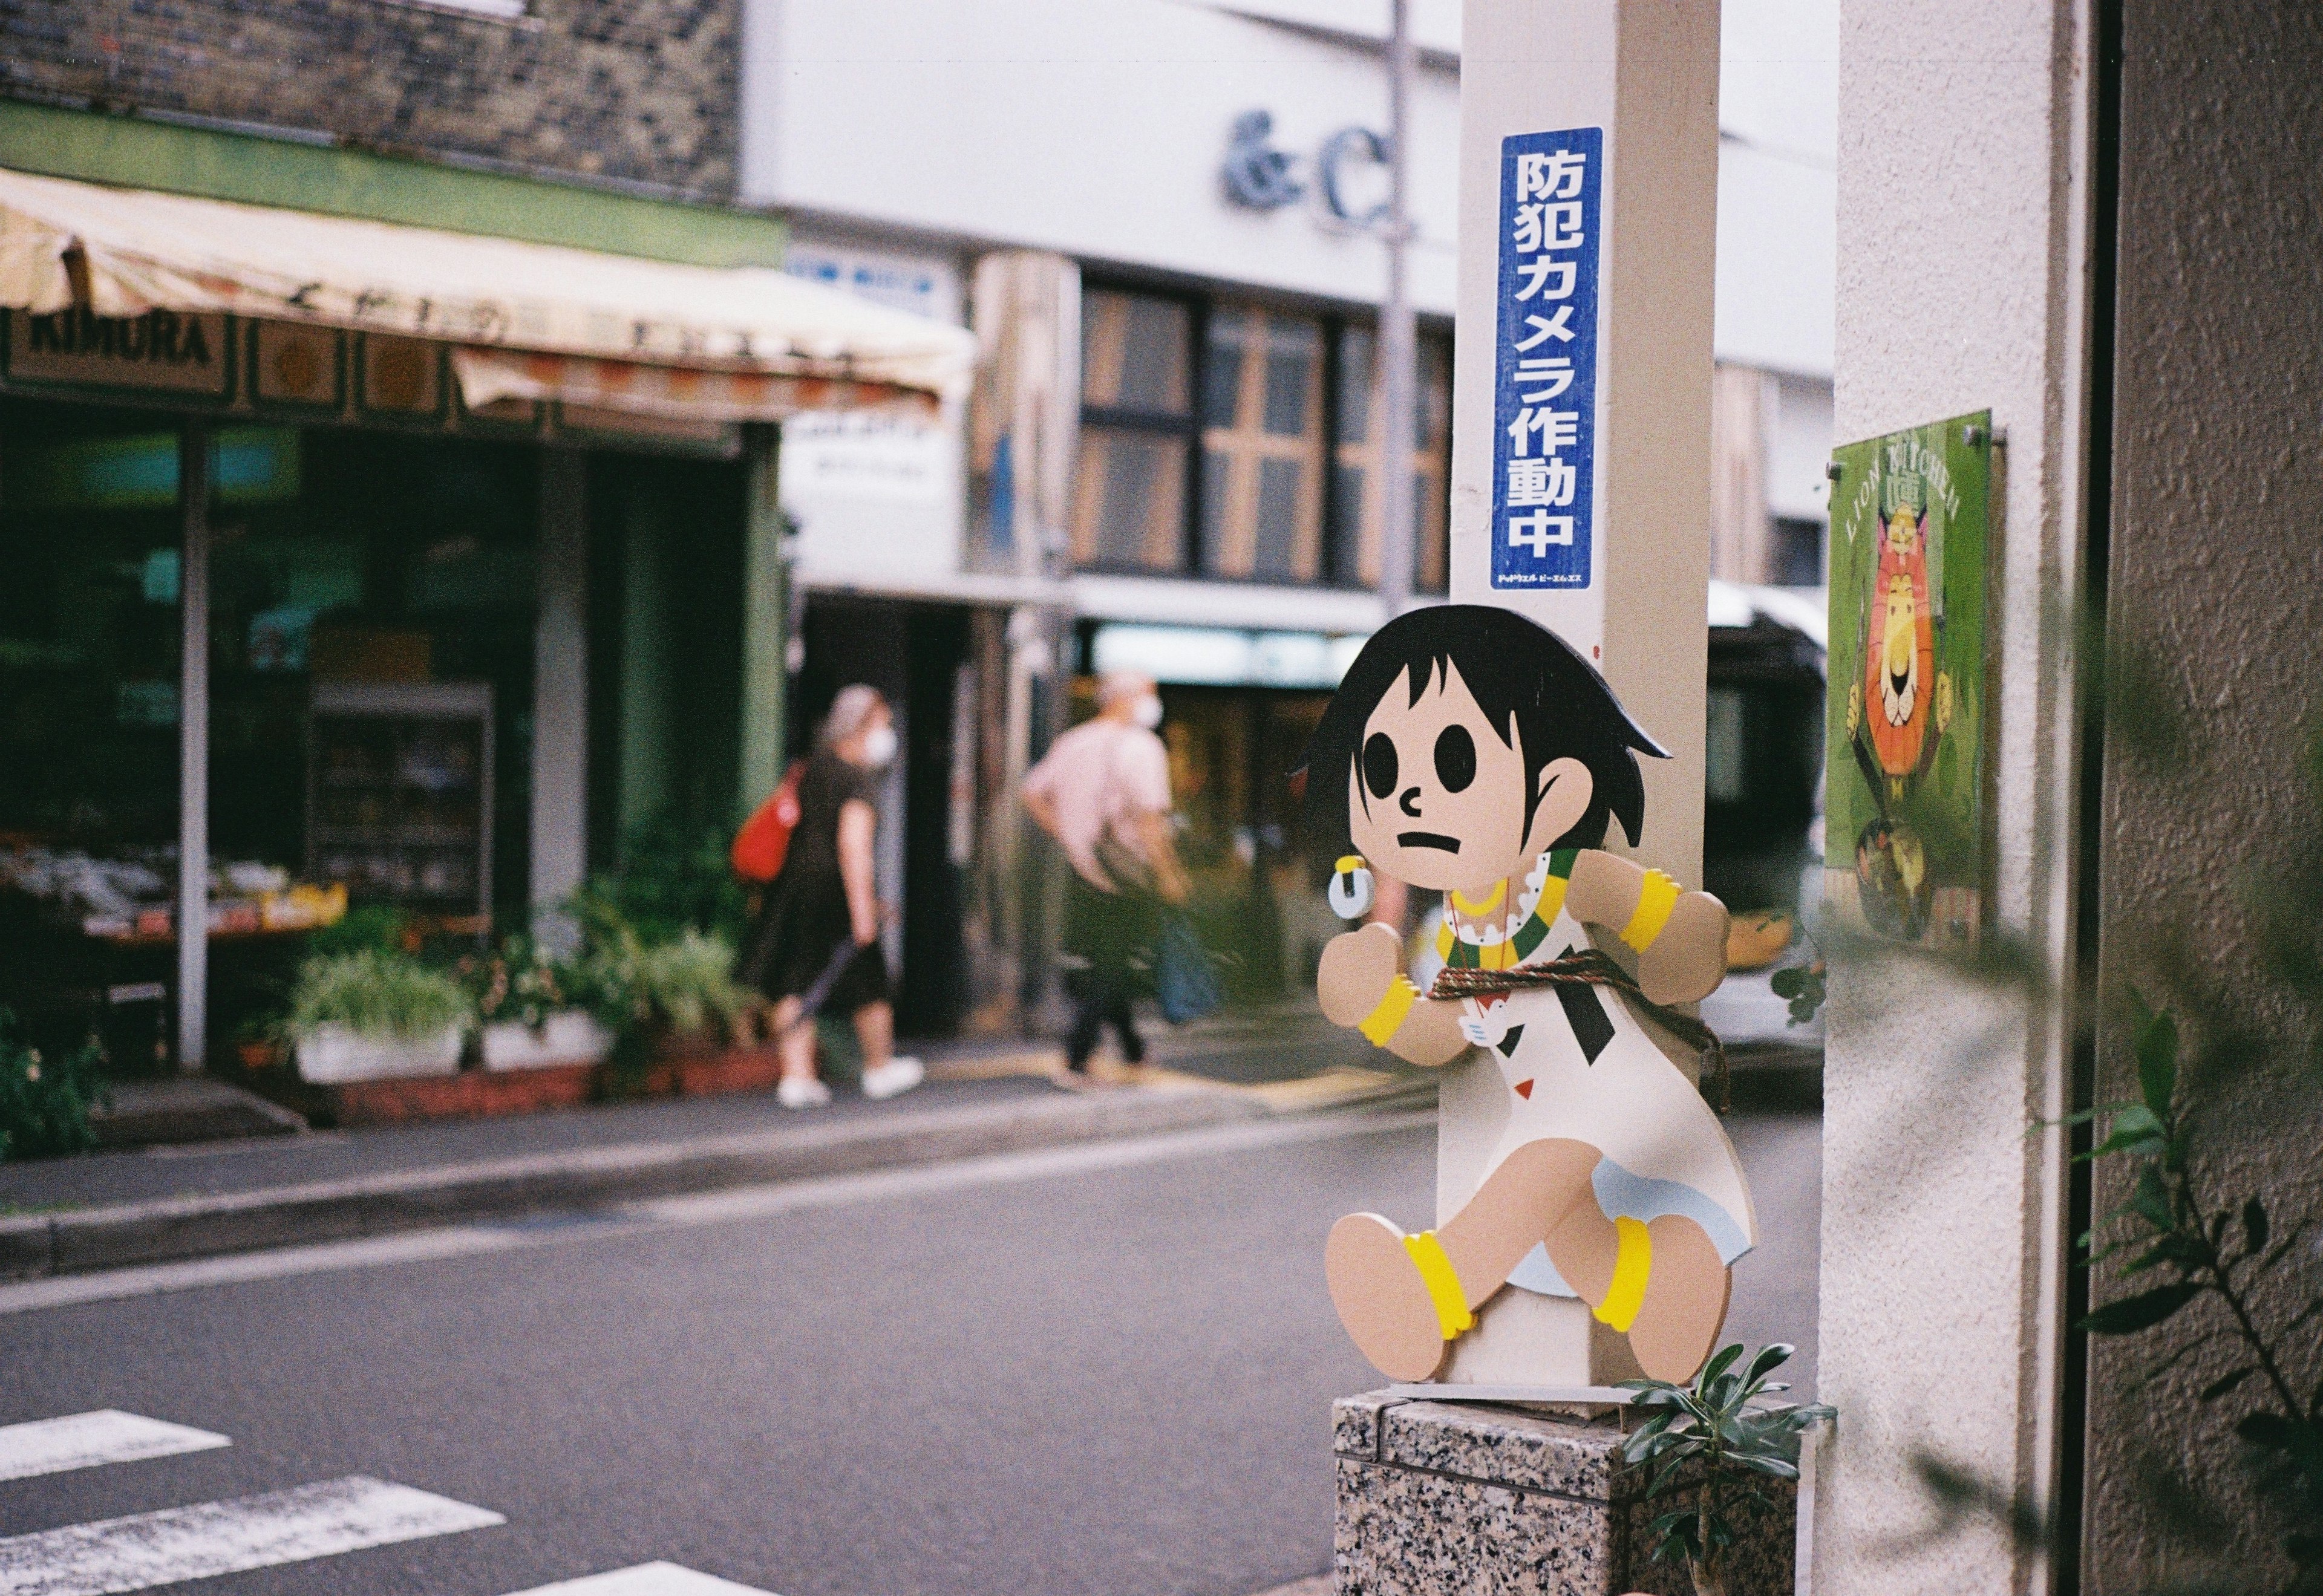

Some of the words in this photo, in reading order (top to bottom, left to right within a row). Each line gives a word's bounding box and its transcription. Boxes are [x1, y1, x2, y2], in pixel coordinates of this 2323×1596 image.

[1507, 149, 1586, 558] 防犯カメラ作動中
[1846, 458, 1880, 544] LION
